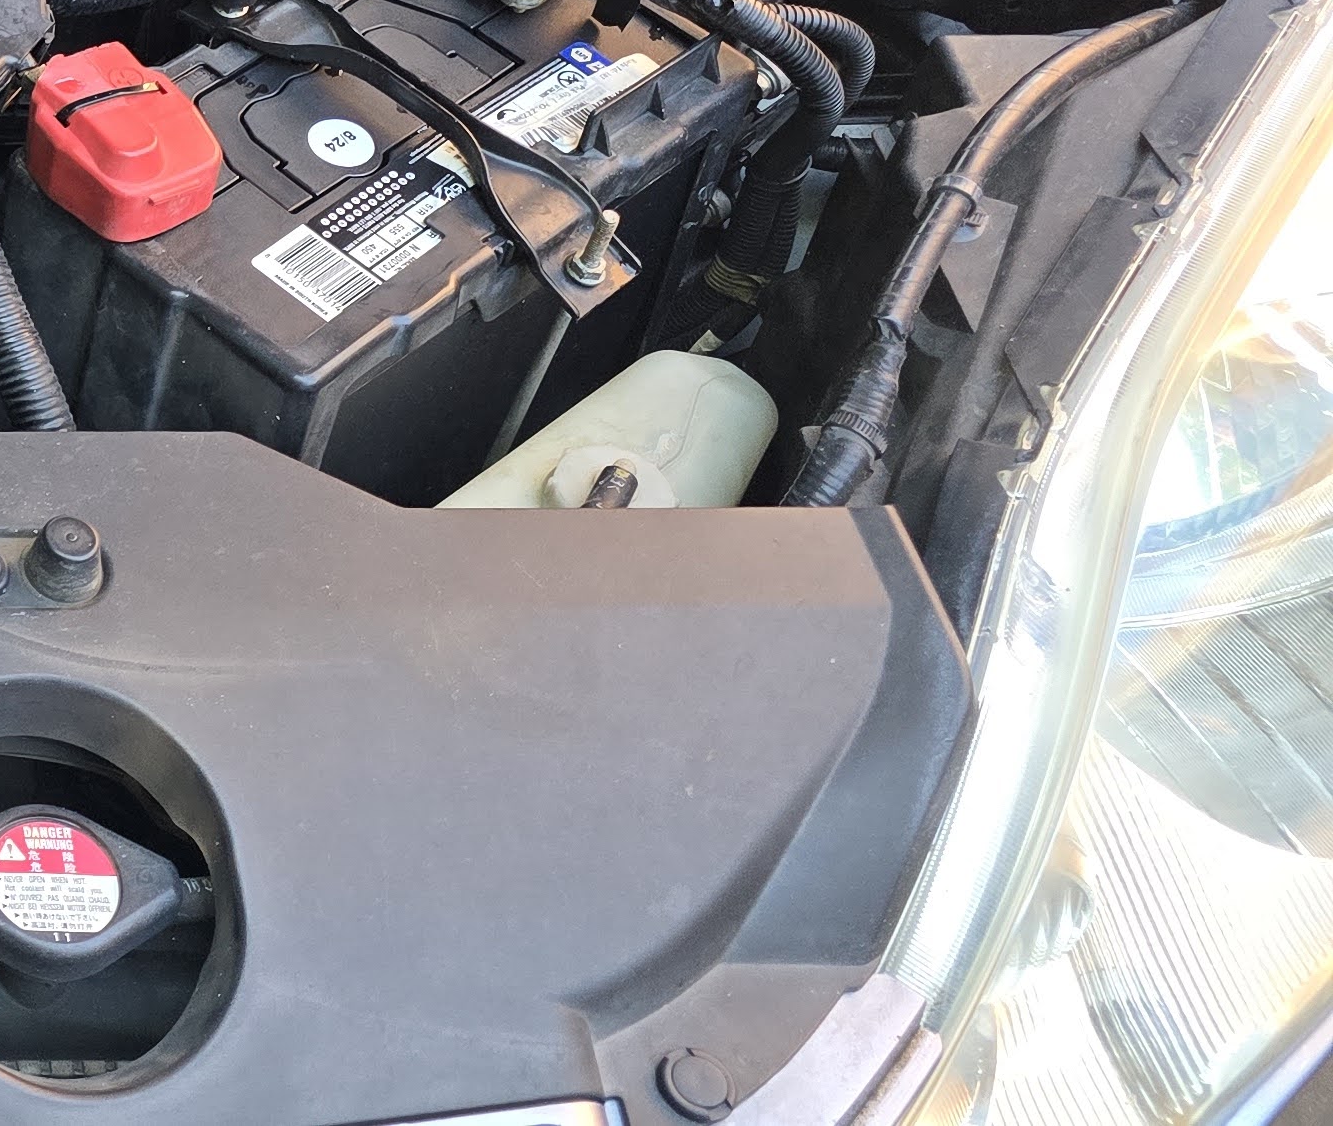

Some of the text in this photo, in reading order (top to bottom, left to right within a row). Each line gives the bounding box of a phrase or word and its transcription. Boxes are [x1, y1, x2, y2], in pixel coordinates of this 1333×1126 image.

[323, 130, 357, 152] 8/24
[416, 203, 434, 216] 51R
[360, 243, 376, 255] 450
[22, 825, 72, 839] DANGER
[24, 838, 74, 851] WARNUNG
[47, 894, 60, 902] PAS
